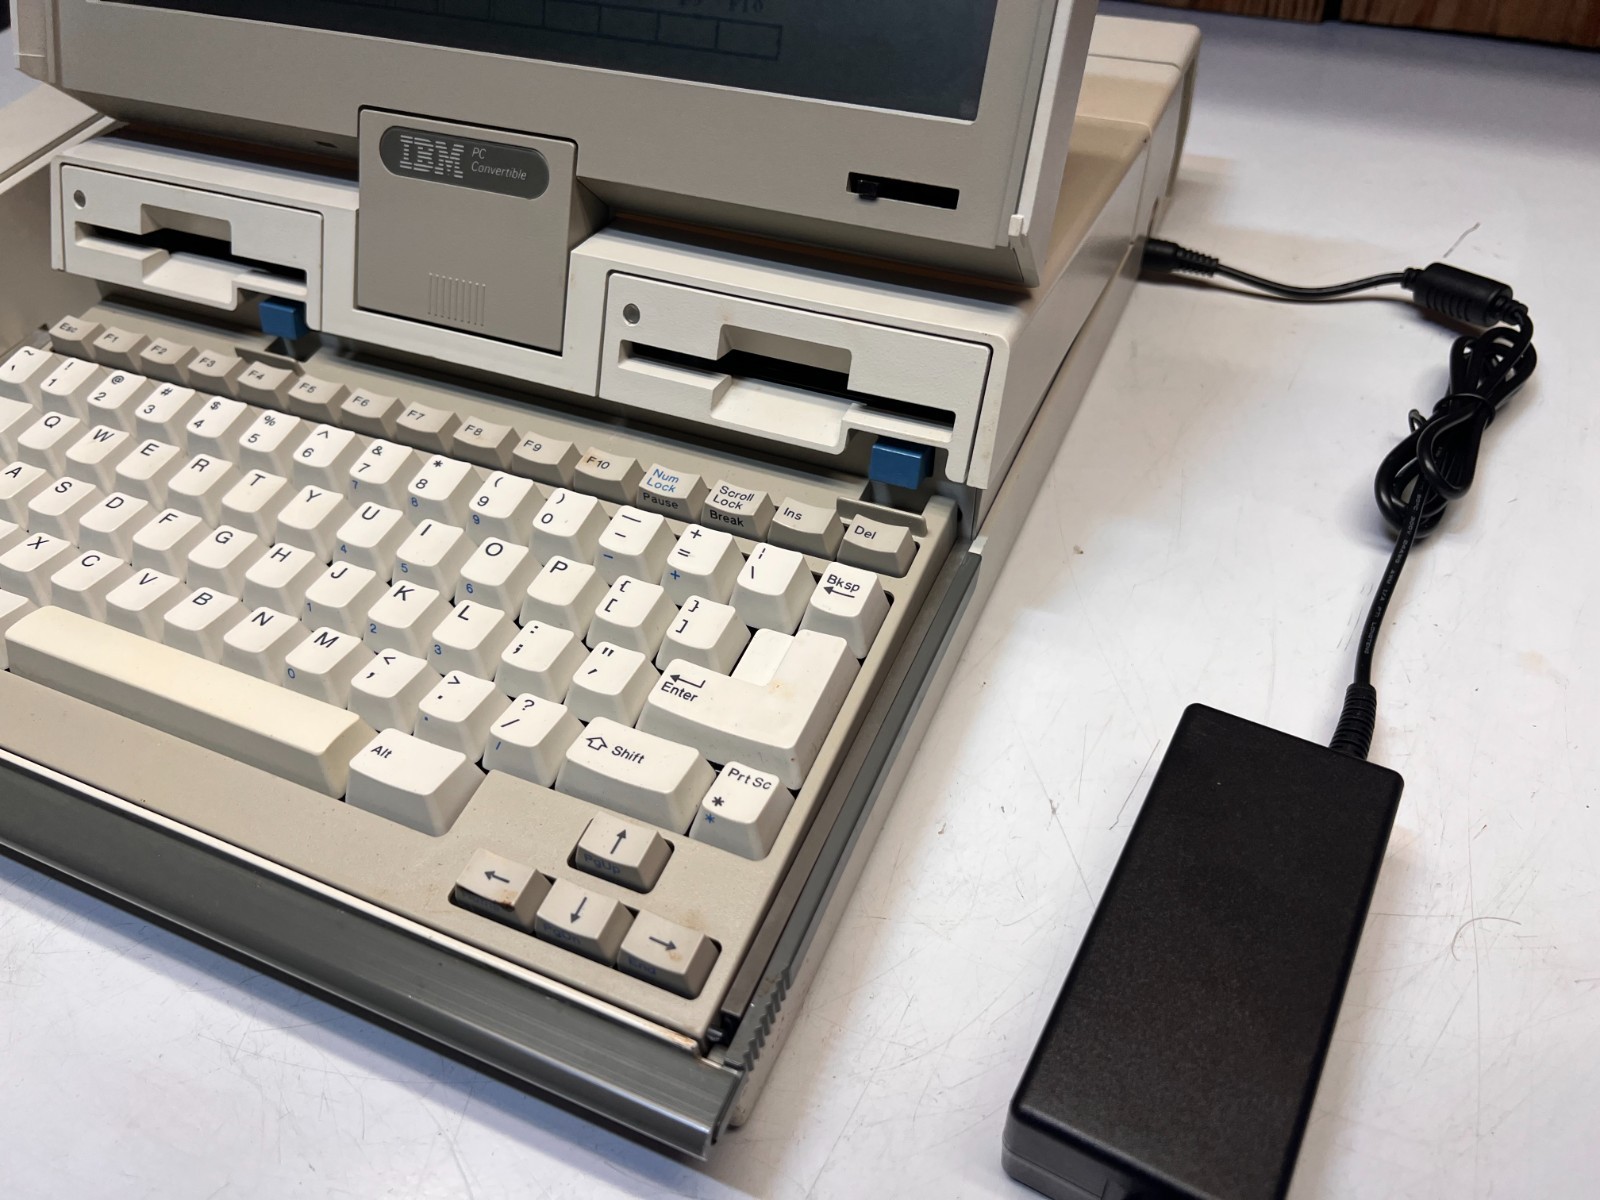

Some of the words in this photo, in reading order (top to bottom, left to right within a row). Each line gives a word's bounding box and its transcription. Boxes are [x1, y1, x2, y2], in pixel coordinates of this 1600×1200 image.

[399, 134, 464, 179] IBM
[471, 147, 487, 160] PC
[471, 161, 527, 181] Convertible
[59, 321, 78, 334] Esc
[103, 332, 119, 344] F1
[150, 344, 168, 355] F2
[198, 356, 216, 368] F3
[248, 369, 265, 381] F4
[47, 378, 58, 387] 1
[299, 382, 317, 394] F5
[94, 392, 107, 402] 2
[352, 395, 370, 407] F6
[143, 404, 156, 414] 3
[406, 409, 426, 421] F7
[44, 415, 61, 429] Q
[193, 419, 205, 429] 4
[93, 428, 115, 443] W
[464, 424, 483, 437] F8
[247, 433, 261, 444] 5
[523, 439, 542, 452] F9
[140, 443, 160, 457] E
[302, 447, 314, 458] 6
[191, 458, 210, 472] R
[357, 462, 371, 474] 7
[586, 456, 610, 470] F10
[5, 466, 23, 478] A
[653, 468, 680, 484] Num
[250, 473, 266, 486] T
[352, 480, 359, 490] 7
[415, 478, 429, 490] 8
[646, 477, 676, 494] Lock
[54, 481, 73, 494] S
[719, 485, 755, 502] Scroll
[105, 496, 125, 510] D
[305, 489, 322, 503] Y
[411, 497, 419, 507] 8
[476, 495, 490, 507] 9
[643, 492, 679, 510] Pause
[713, 494, 744, 511] Lock
[158, 512, 179, 525] F
[361, 505, 381, 521] U
[472, 514, 480, 525] 9
[540, 512, 554, 525] 0
[709, 509, 745, 527] Break
[783, 507, 803, 521] Ins
[419, 523, 433, 537] I
[854, 525, 877, 540] Del
[26, 536, 50, 550] X
[214, 530, 234, 545] G
[270, 546, 292, 563] H
[340, 544, 347, 554] 4
[485, 542, 504, 557] O
[81, 555, 101, 567] C
[400, 563, 408, 573] 5
[549, 560, 568, 574] P
[139, 572, 158, 586] V
[330, 567, 348, 580] J
[465, 583, 474, 594] 6
[826, 574, 861, 593] Bksp
[192, 592, 213, 606] B
[393, 585, 415, 602] K
[251, 611, 275, 627] N
[457, 605, 471, 621] L
[369, 623, 377, 634] 2
[313, 631, 340, 649] M
[434, 644, 442, 655] 3
[660, 681, 698, 702] Enter
[370, 745, 393, 759] Alt
[611, 746, 645, 765] Shift
[583, 853, 621, 875] PgUp
[543, 922, 581, 946] PgDn
[628, 956, 656, 976] End
